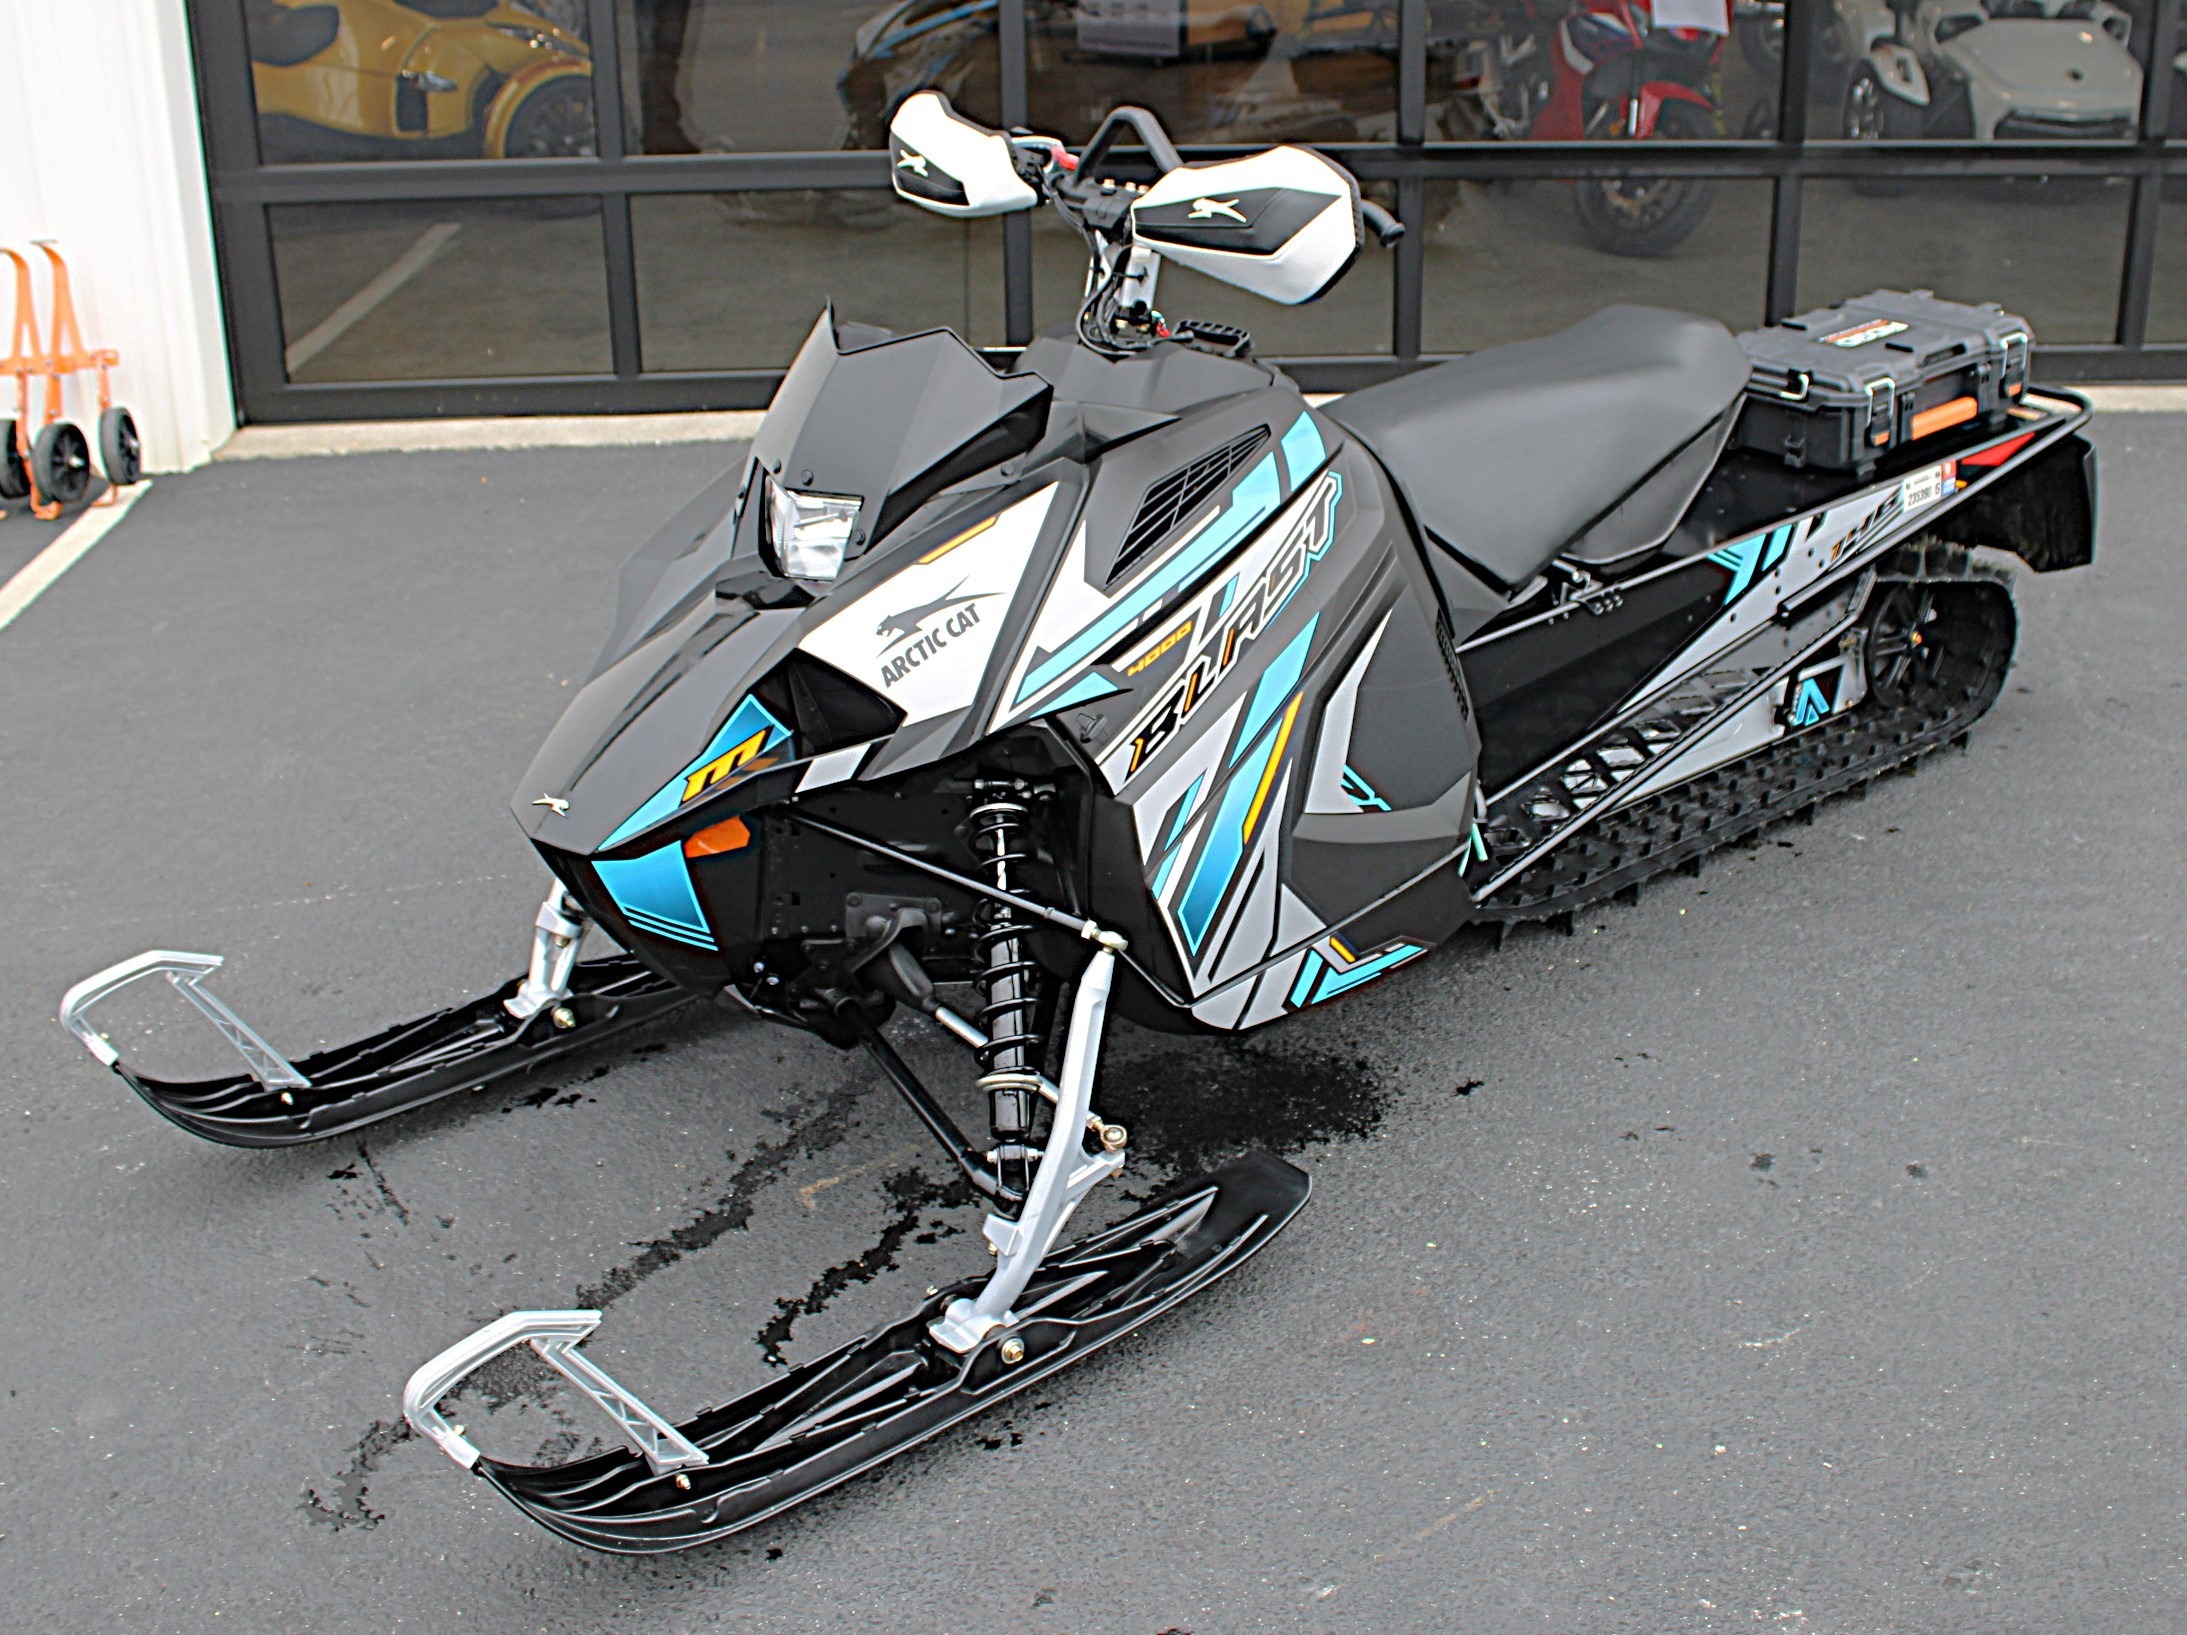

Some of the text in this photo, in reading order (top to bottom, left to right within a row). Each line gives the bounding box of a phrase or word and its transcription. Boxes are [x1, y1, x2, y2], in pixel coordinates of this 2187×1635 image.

[880, 602, 980, 688] ARCTIC CAT
[1123, 472, 1341, 783] BLAST
[1126, 620, 1193, 677] 4000
